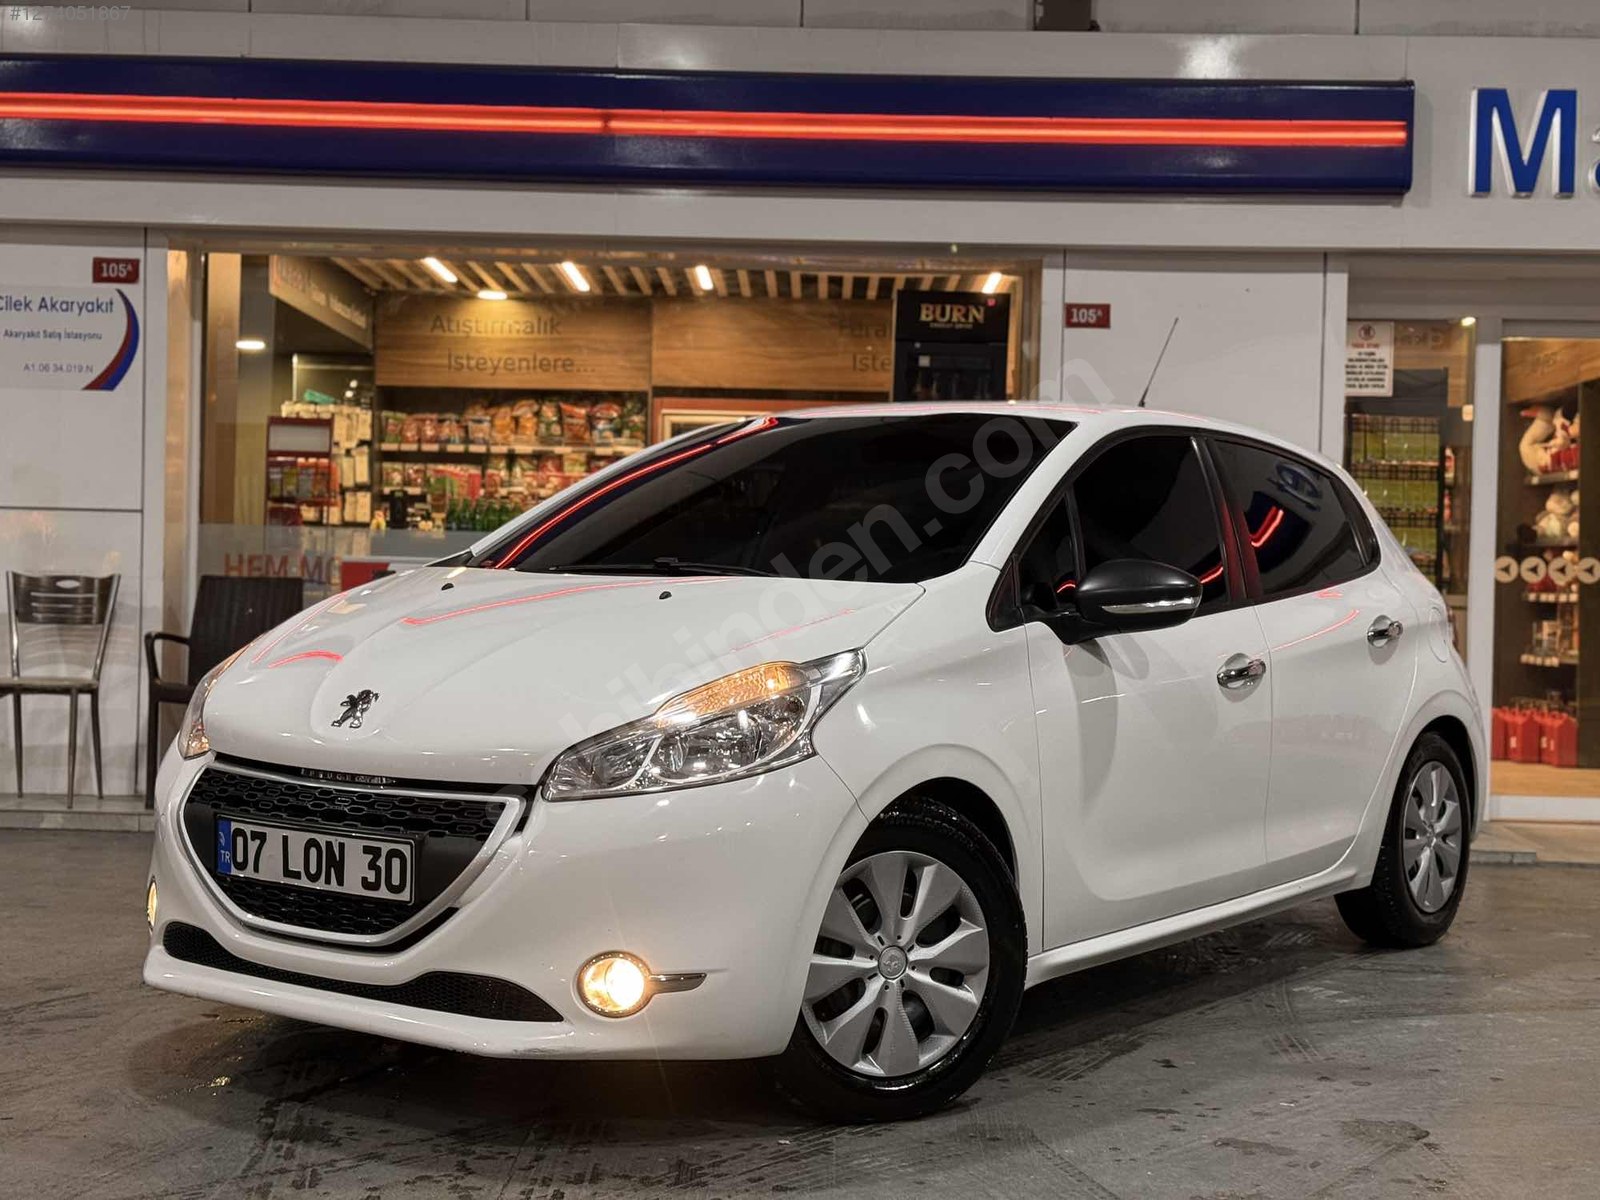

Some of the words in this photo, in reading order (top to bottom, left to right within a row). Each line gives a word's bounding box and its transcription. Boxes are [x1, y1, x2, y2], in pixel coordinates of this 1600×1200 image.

[1468, 88, 1600, 199] M
[920, 303, 985, 323] BURN
[220, 849, 231, 864] TR
[231, 827, 268, 873] 07
[282, 834, 346, 887] LON
[361, 844, 408, 894] 30
